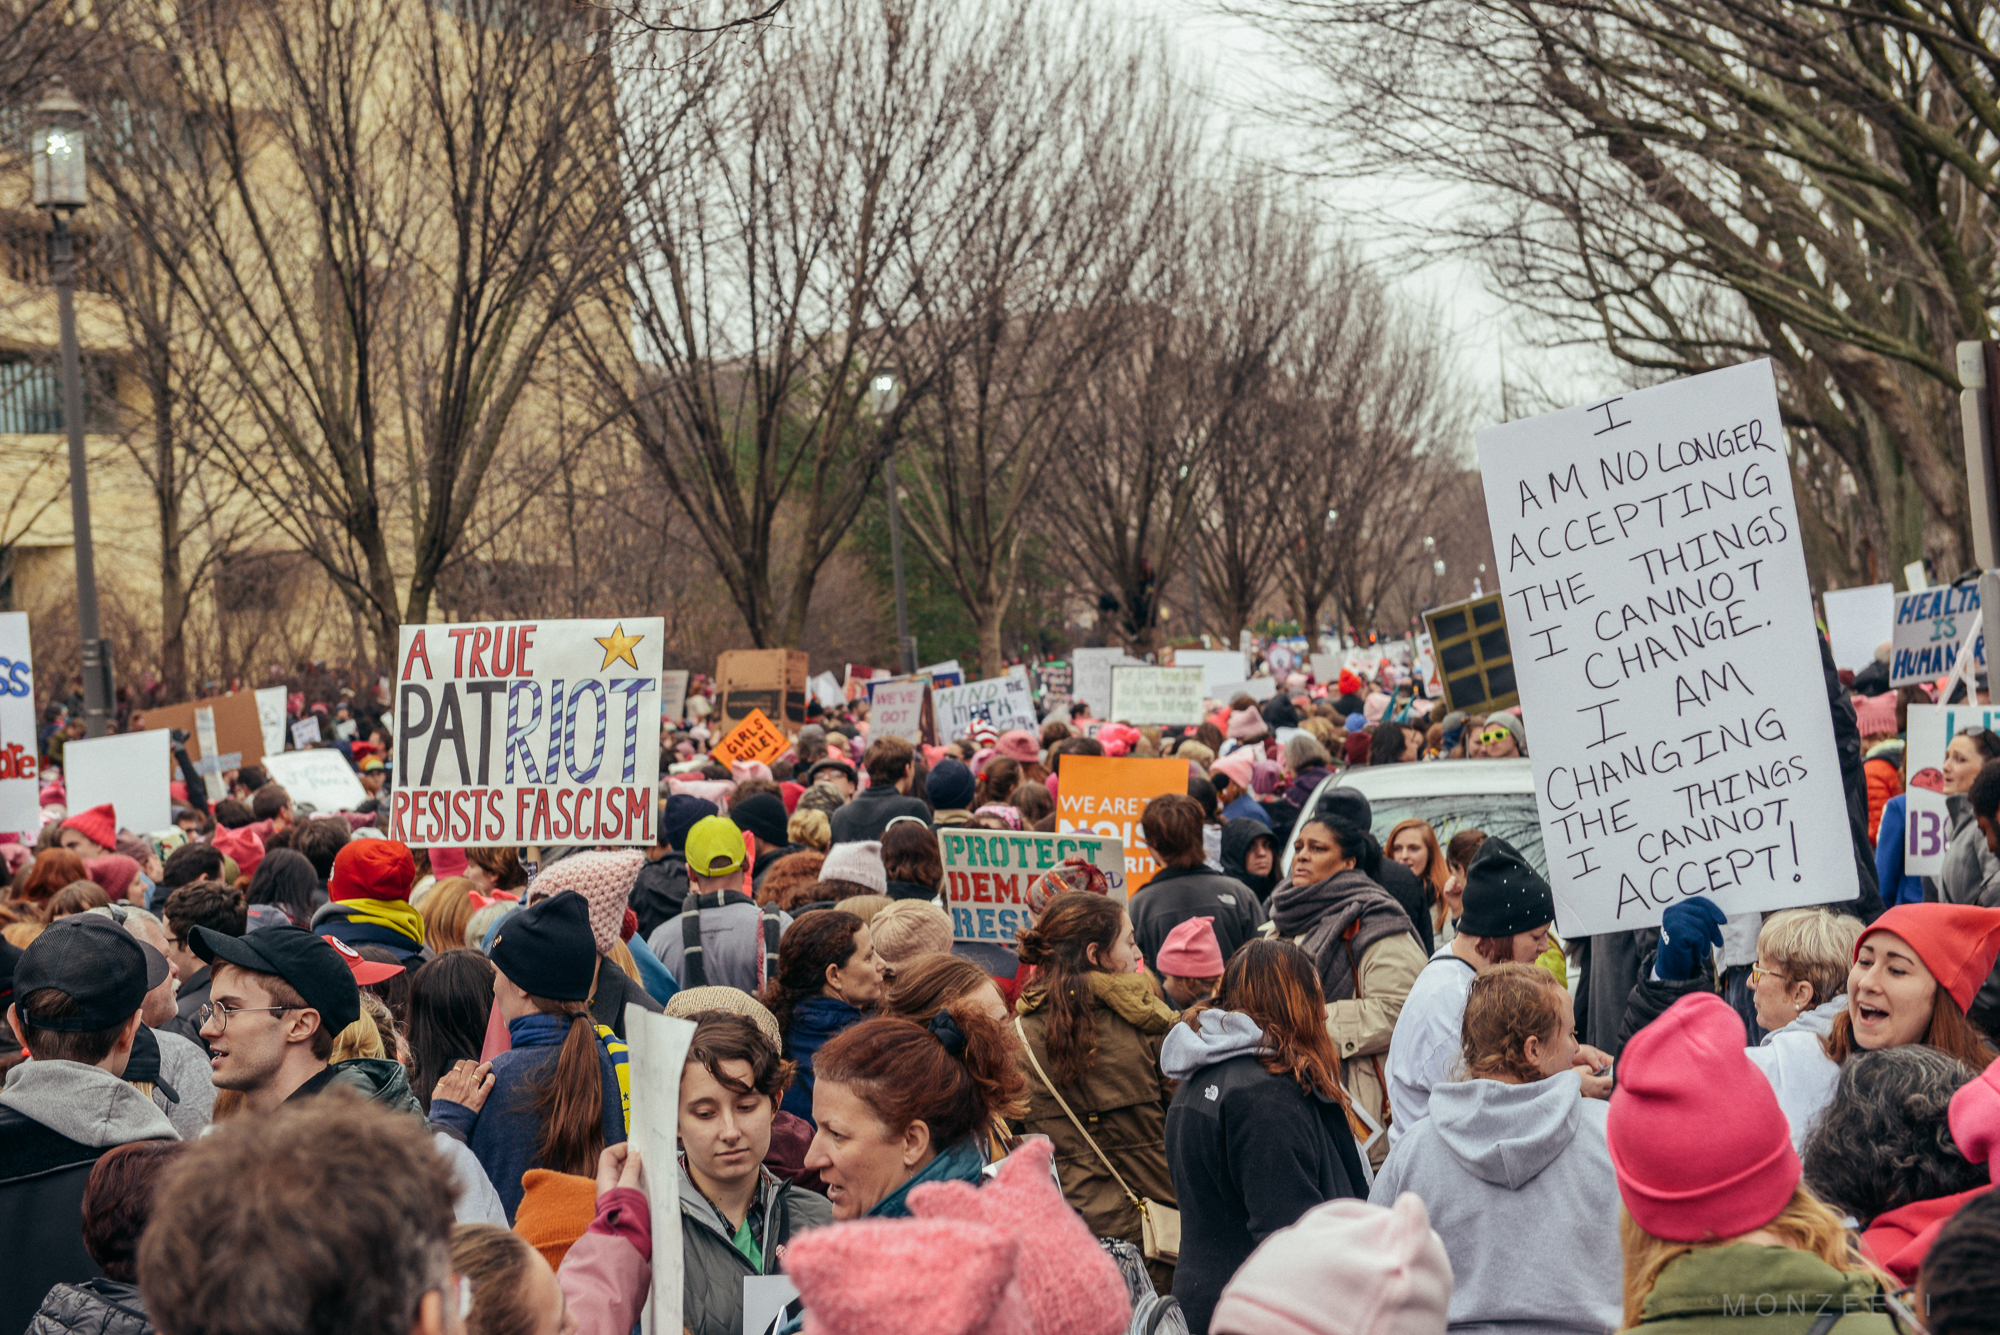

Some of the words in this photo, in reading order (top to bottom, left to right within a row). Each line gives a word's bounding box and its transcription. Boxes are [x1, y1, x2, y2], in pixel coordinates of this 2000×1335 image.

[1587, 397, 1632, 435] I
[1519, 463, 1588, 518] AM
[1600, 450, 1649, 491] NO
[1658, 419, 1777, 472] LONGER
[1509, 463, 1772, 573] ACCEPTING
[1509, 572, 1595, 621] THE
[1629, 506, 1788, 584] THINGS
[1529, 624, 1568, 661] I
[1595, 559, 1763, 641] CANNOT
[1930, 617, 1956, 641] IS
[401, 628, 434, 681] A
[448, 625, 538, 678] TRUE
[1585, 599, 1772, 689] CHANGE.
[1892, 640, 1960, 680] HUMAN
[881, 709, 909, 724] GOT
[939, 682, 998, 708] MIND
[1576, 698, 1627, 749] I
[1676, 661, 1755, 717] AM
[398, 678, 656, 787] PATRIOT
[727, 718, 764, 755] GIRLS
[735, 729, 778, 762] RULE!
[1546, 708, 1787, 811] CHANGING
[391, 788, 505, 842] RESISTS
[516, 787, 656, 841] FASCISM.
[1060, 795, 1095, 814] WE
[1098, 797, 1138, 815] ARE
[1550, 799, 1638, 844] THE
[1673, 755, 1808, 818] THINGS
[944, 835, 1102, 869] PROTECT
[1566, 847, 1602, 880] I
[1637, 798, 1789, 864] CANNOT
[948, 871, 1042, 904] DEM
[1616, 820, 1802, 920] ACCEPT!
